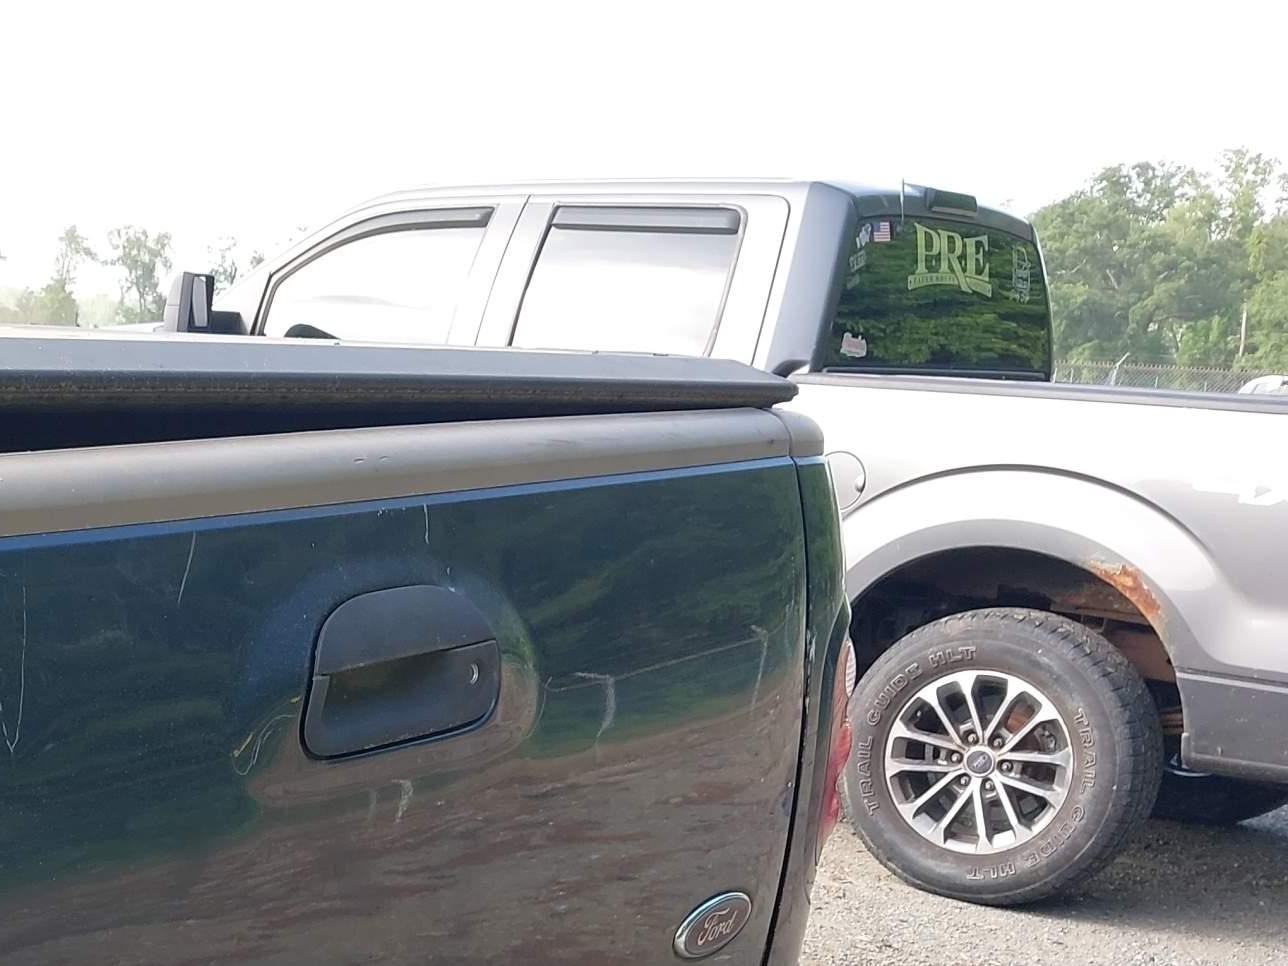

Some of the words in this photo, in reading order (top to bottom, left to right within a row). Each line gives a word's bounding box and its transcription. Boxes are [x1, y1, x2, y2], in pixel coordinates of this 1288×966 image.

[929, 646, 976, 668] HLT
[868, 663, 925, 726] GUIDE
[857, 736, 880, 816] TRAIL
[1075, 707, 1097, 793] TRAIL
[697, 907, 737, 946] Ford
